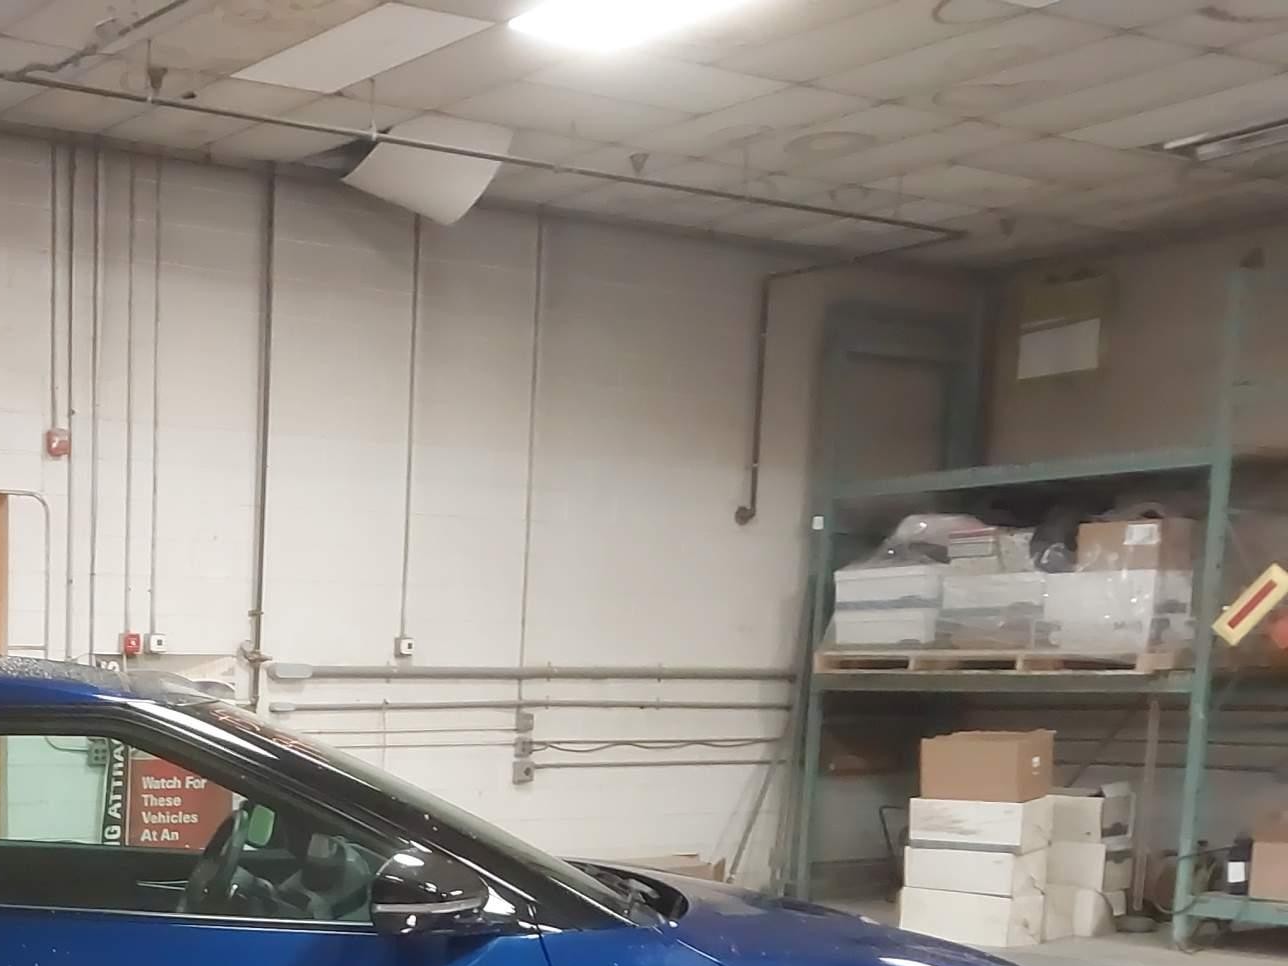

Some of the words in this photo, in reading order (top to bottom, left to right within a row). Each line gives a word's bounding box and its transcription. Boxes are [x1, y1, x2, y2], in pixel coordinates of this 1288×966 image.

[141, 776, 182, 789] Watch
[185, 776, 207, 789] For
[141, 794, 182, 807] These
[141, 811, 199, 824] Vehicles
[140, 829, 158, 842] At
[160, 828, 179, 842] An
